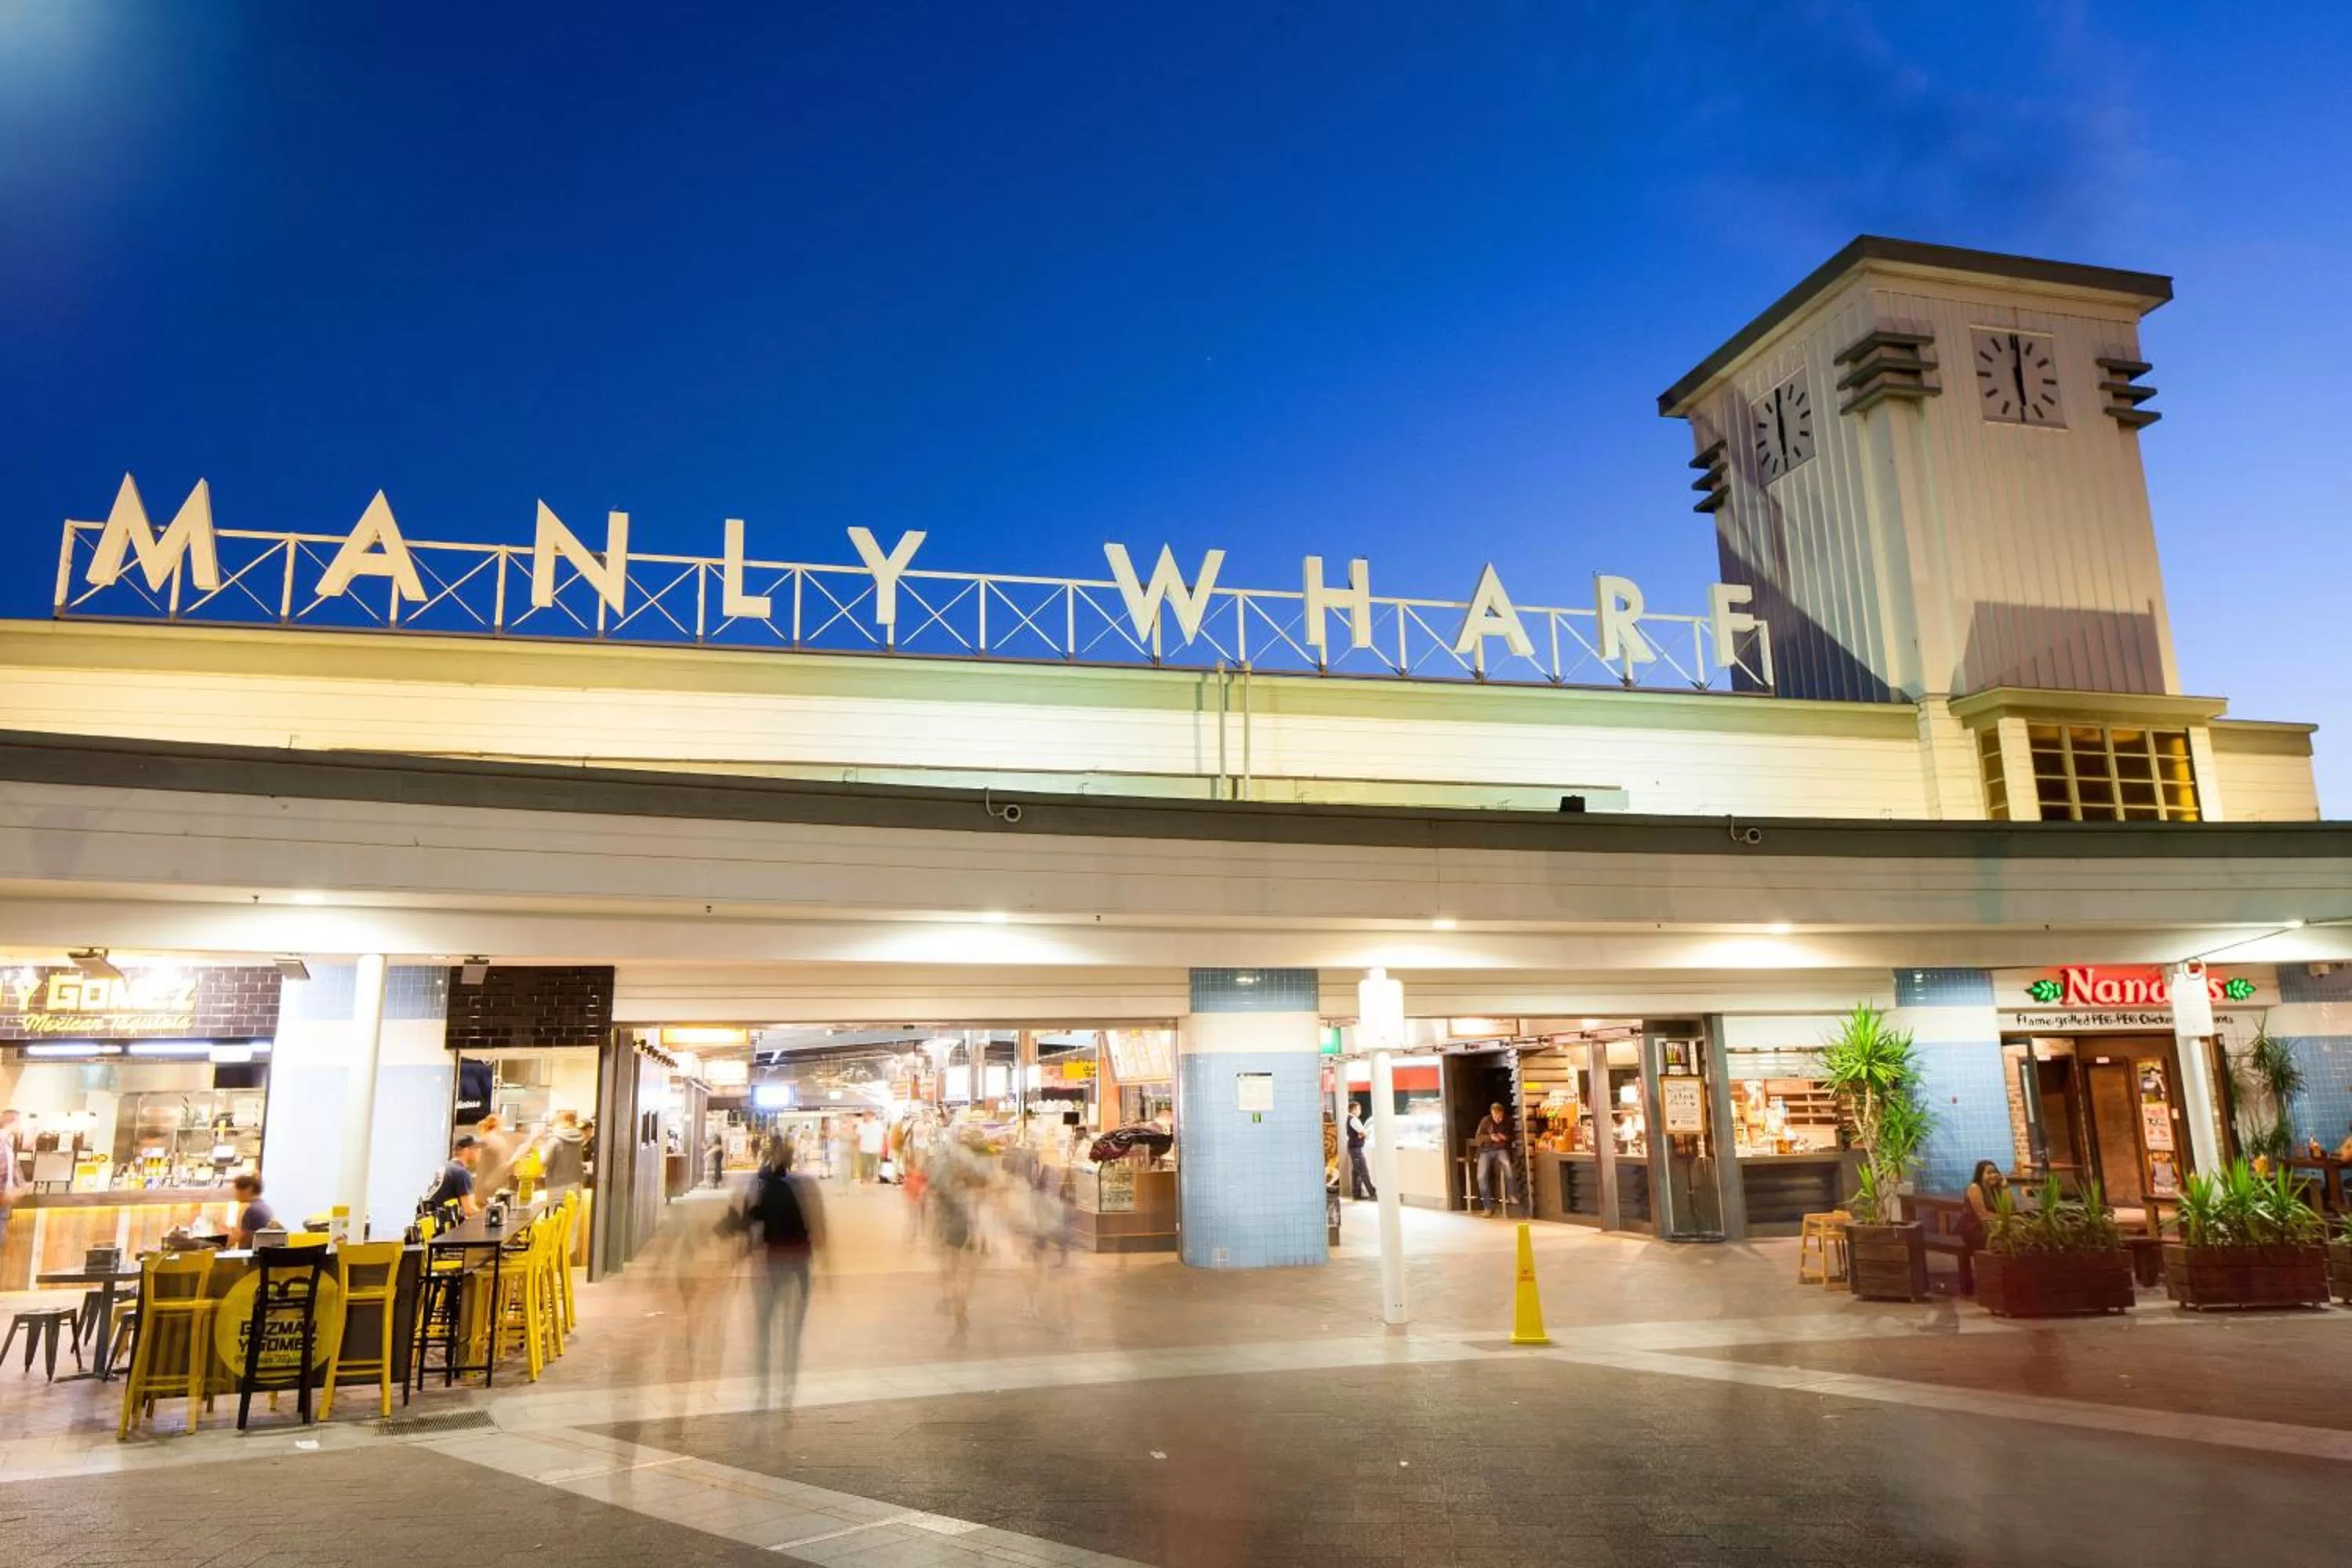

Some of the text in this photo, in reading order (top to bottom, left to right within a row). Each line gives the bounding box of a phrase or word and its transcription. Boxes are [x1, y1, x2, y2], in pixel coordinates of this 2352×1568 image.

[85, 470, 1756, 668] MANLY WHARF
[2060, 966, 2225, 1004] Nands
[240, 1320, 317, 1336] GZMA
